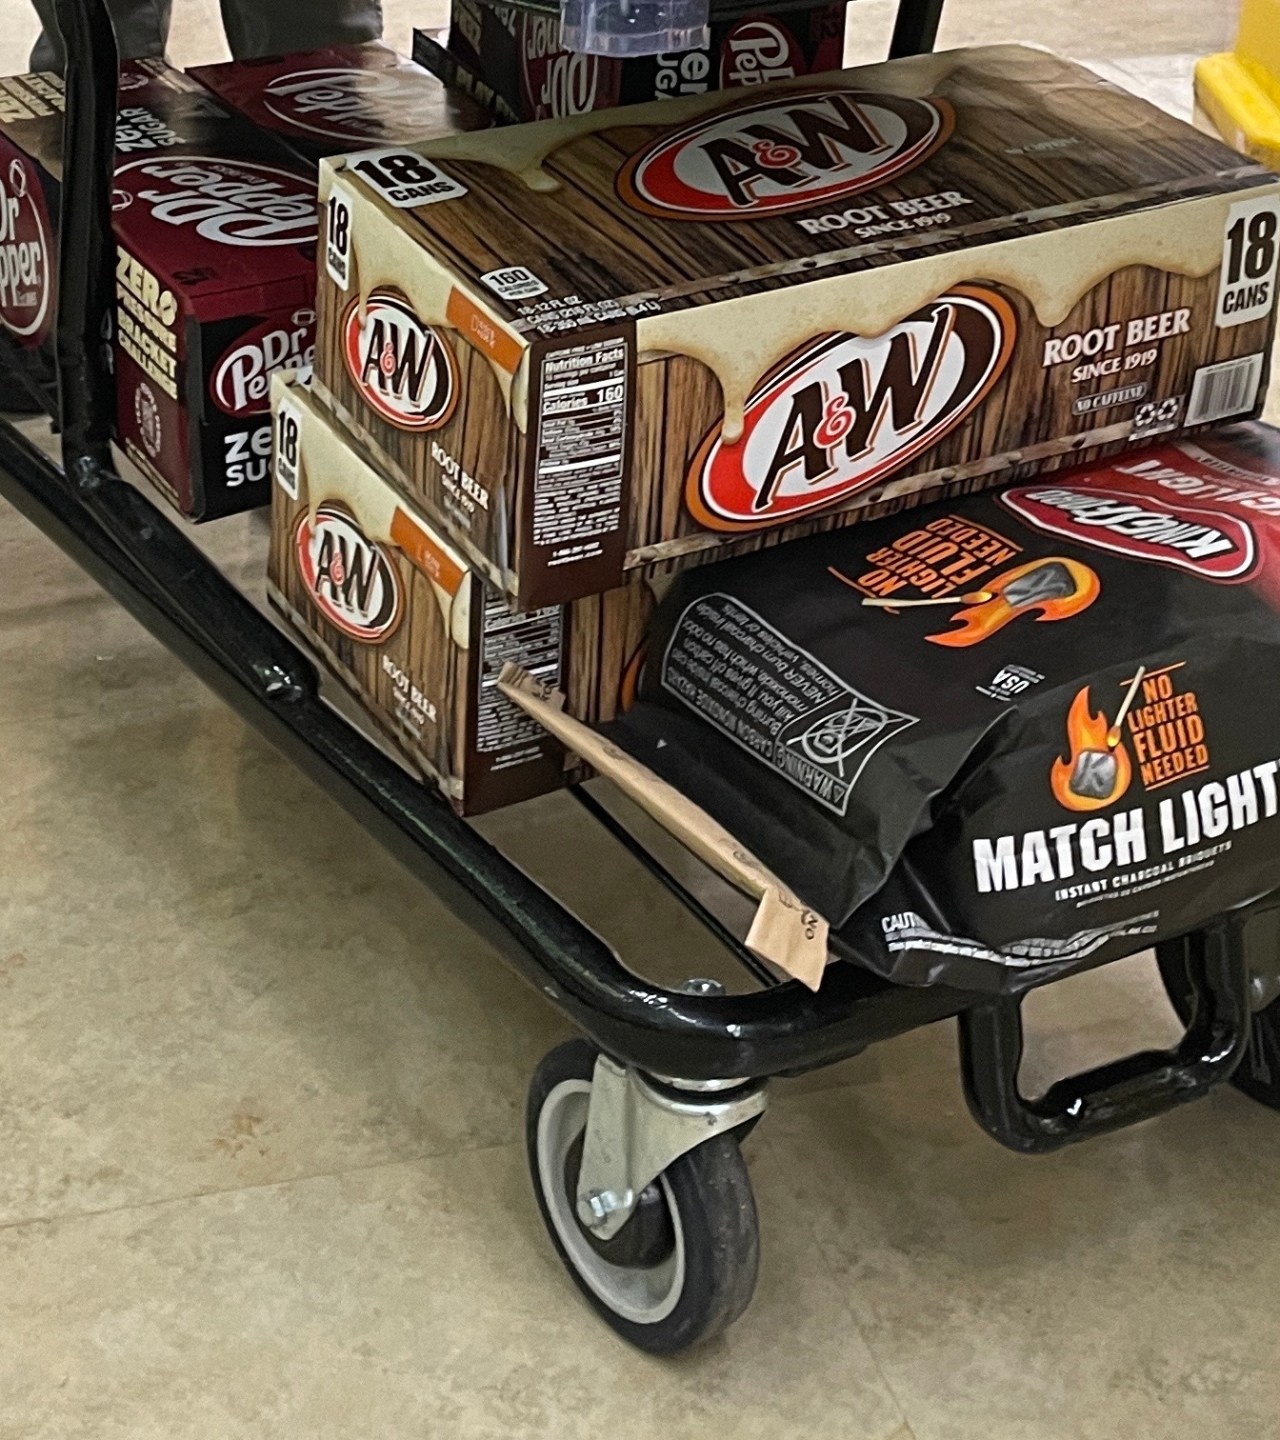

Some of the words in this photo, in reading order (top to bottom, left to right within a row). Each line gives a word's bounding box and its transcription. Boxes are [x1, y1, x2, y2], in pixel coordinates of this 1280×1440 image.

[352, 154, 438, 189] 18
[698, 94, 887, 209] A&W
[140, 165, 319, 247] Pepper
[387, 179, 455, 203] CANS
[796, 205, 884, 237] ROOT
[889, 188, 974, 221] BEER
[329, 196, 349, 256] 18
[853, 220, 906, 240] SINCE
[907, 210, 951, 230] 1919
[1227, 211, 1277, 285] 18
[117, 244, 178, 327] ZERO
[488, 268, 530, 286] 160
[1222, 281, 1270, 316] CANS
[262, 328, 308, 363] Dr
[363, 315, 436, 403] A&W
[545, 354, 593, 375] Nutrition
[595, 346, 625, 365] Facts
[1042, 323, 1121, 368] ROOT
[1125, 307, 1192, 348] BEER
[1071, 355, 1122, 384] SINCE
[1123, 347, 1158, 371] 1919
[542, 396, 588, 415] Calories
[596, 385, 625, 405] 160
[753, 303, 957, 515] A&W
[279, 411, 298, 468] 18
[431, 440, 460, 481] ROOT
[460, 470, 489, 511] BEER
[924, 517, 1018, 568] NEEDED
[1029, 489, 1233, 559] KINGSFORD
[316, 530, 379, 615] A&W
[866, 545, 956, 601] LIGHTER
[890, 528, 992, 585] FLUID
[857, 570, 908, 597] NO
[382, 654, 410, 693] ROOT
[410, 685, 436, 723] BEER
[785, 670, 827, 705] NEVER
[990, 668, 1031, 694] USA
[1142, 674, 1174, 704] NO
[1126, 691, 1199, 733] LIGHTER
[1133, 713, 1206, 764] FLUID
[773, 749, 839, 800] WARNING
[1141, 744, 1210, 786] NEEDED
[972, 807, 1148, 895] MATCH
[1159, 760, 1280, 855] LIGHT
[1054, 878, 1108, 902] INSTANT
[1111, 861, 1175, 889] CHARCOAL
